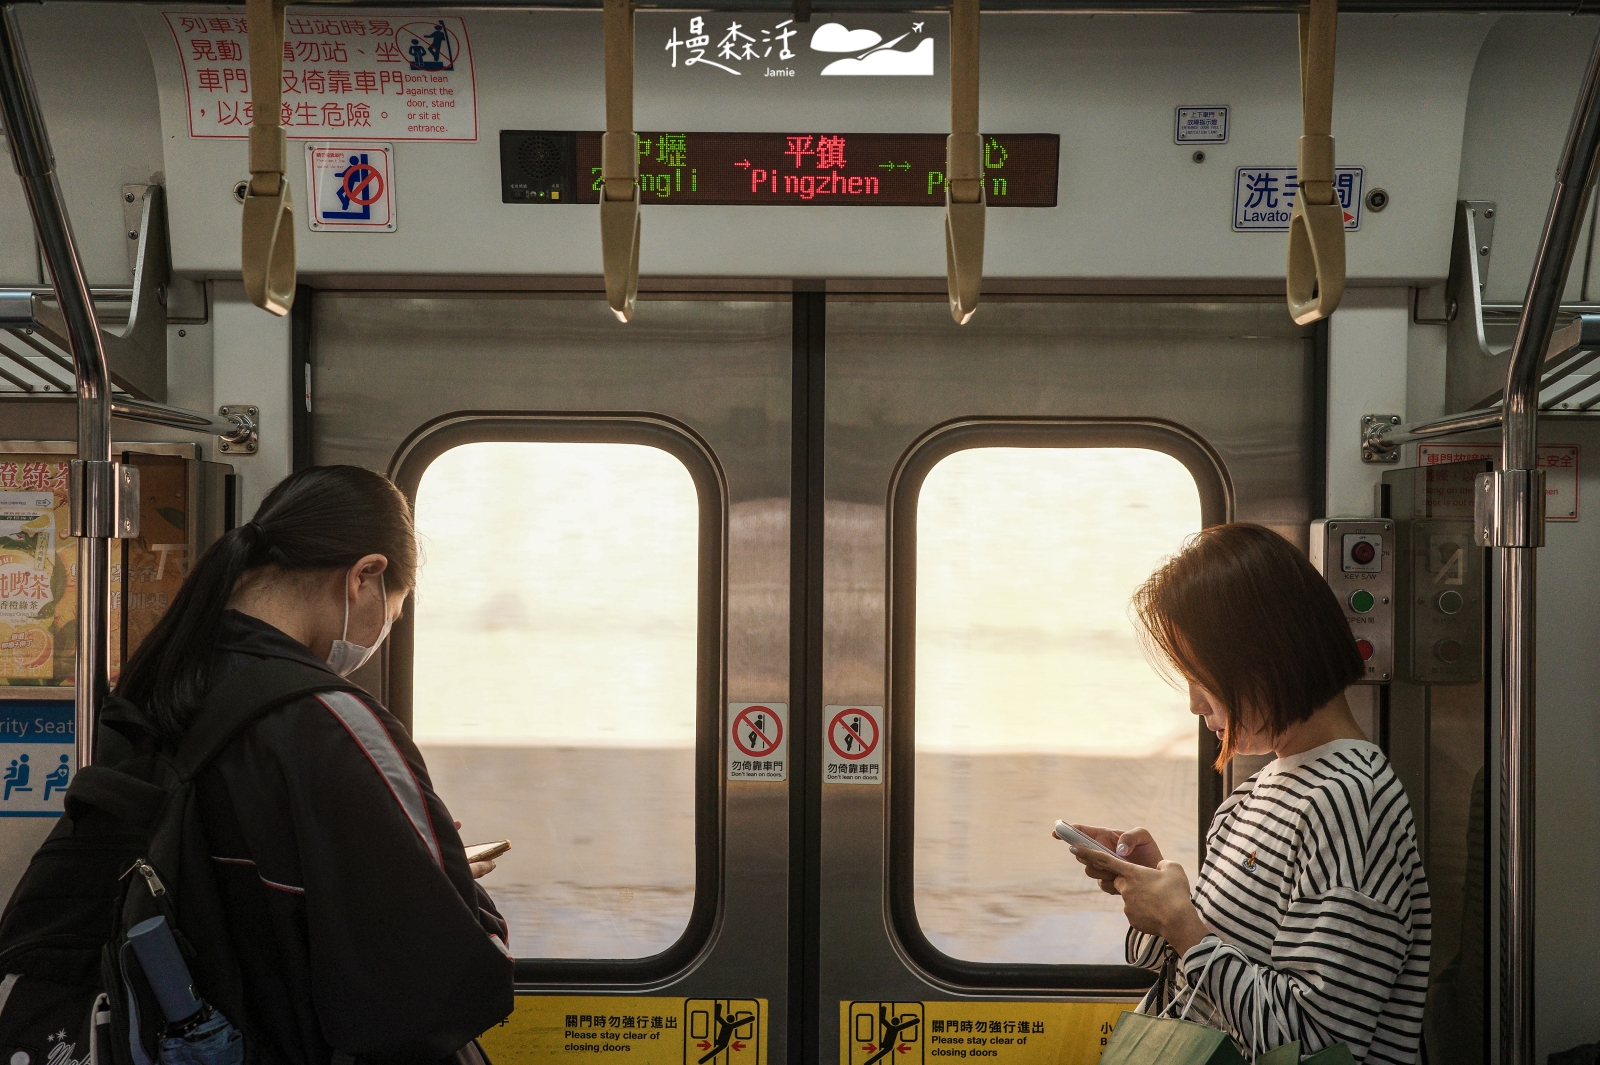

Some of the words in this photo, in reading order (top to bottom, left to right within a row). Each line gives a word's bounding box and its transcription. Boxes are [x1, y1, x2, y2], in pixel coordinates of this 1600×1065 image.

[404, 74, 428, 83] Don't
[430, 74, 449, 83] lean
[406, 86, 437, 97] against
[439, 86, 454, 96] the
[431, 99, 455, 108] stand
[407, 112, 417, 120] or
[418, 111, 429, 120] sit
[431, 112, 441, 120] at
[407, 124, 449, 133] entrance.
[784, 135, 847, 169] 平鎮
[751, 169, 879, 200] Pingzhen
[1459, 486, 1473, 495] the
[1361, 573, 1377, 581] S/W
[1345, 616, 1367, 624] OPEN
[0, 717, 29, 738] rity
[34, 717, 75, 734] Seat
[731, 760, 783, 771] 勿倚靠車門
[827, 763, 879, 774] 勿倚靠車門
[565, 1015, 678, 1029] 關門時勿強行進出
[932, 1020, 1045, 1034] 關門時勿強行進出
[564, 1030, 598, 1040] Please
[600, 1031, 620, 1041] stay
[623, 1031, 648, 1040] clear
[650, 1031, 660, 1040] of
[931, 1035, 964, 1045] Please
[966, 1036, 988, 1047] stay
[990, 1036, 1015, 1045] clear
[1017, 1036, 1027, 1045] of
[564, 1043, 600, 1053] closing
[602, 1043, 631, 1052] doors
[931, 1048, 967, 1058] closing
[969, 1048, 998, 1057] doors
